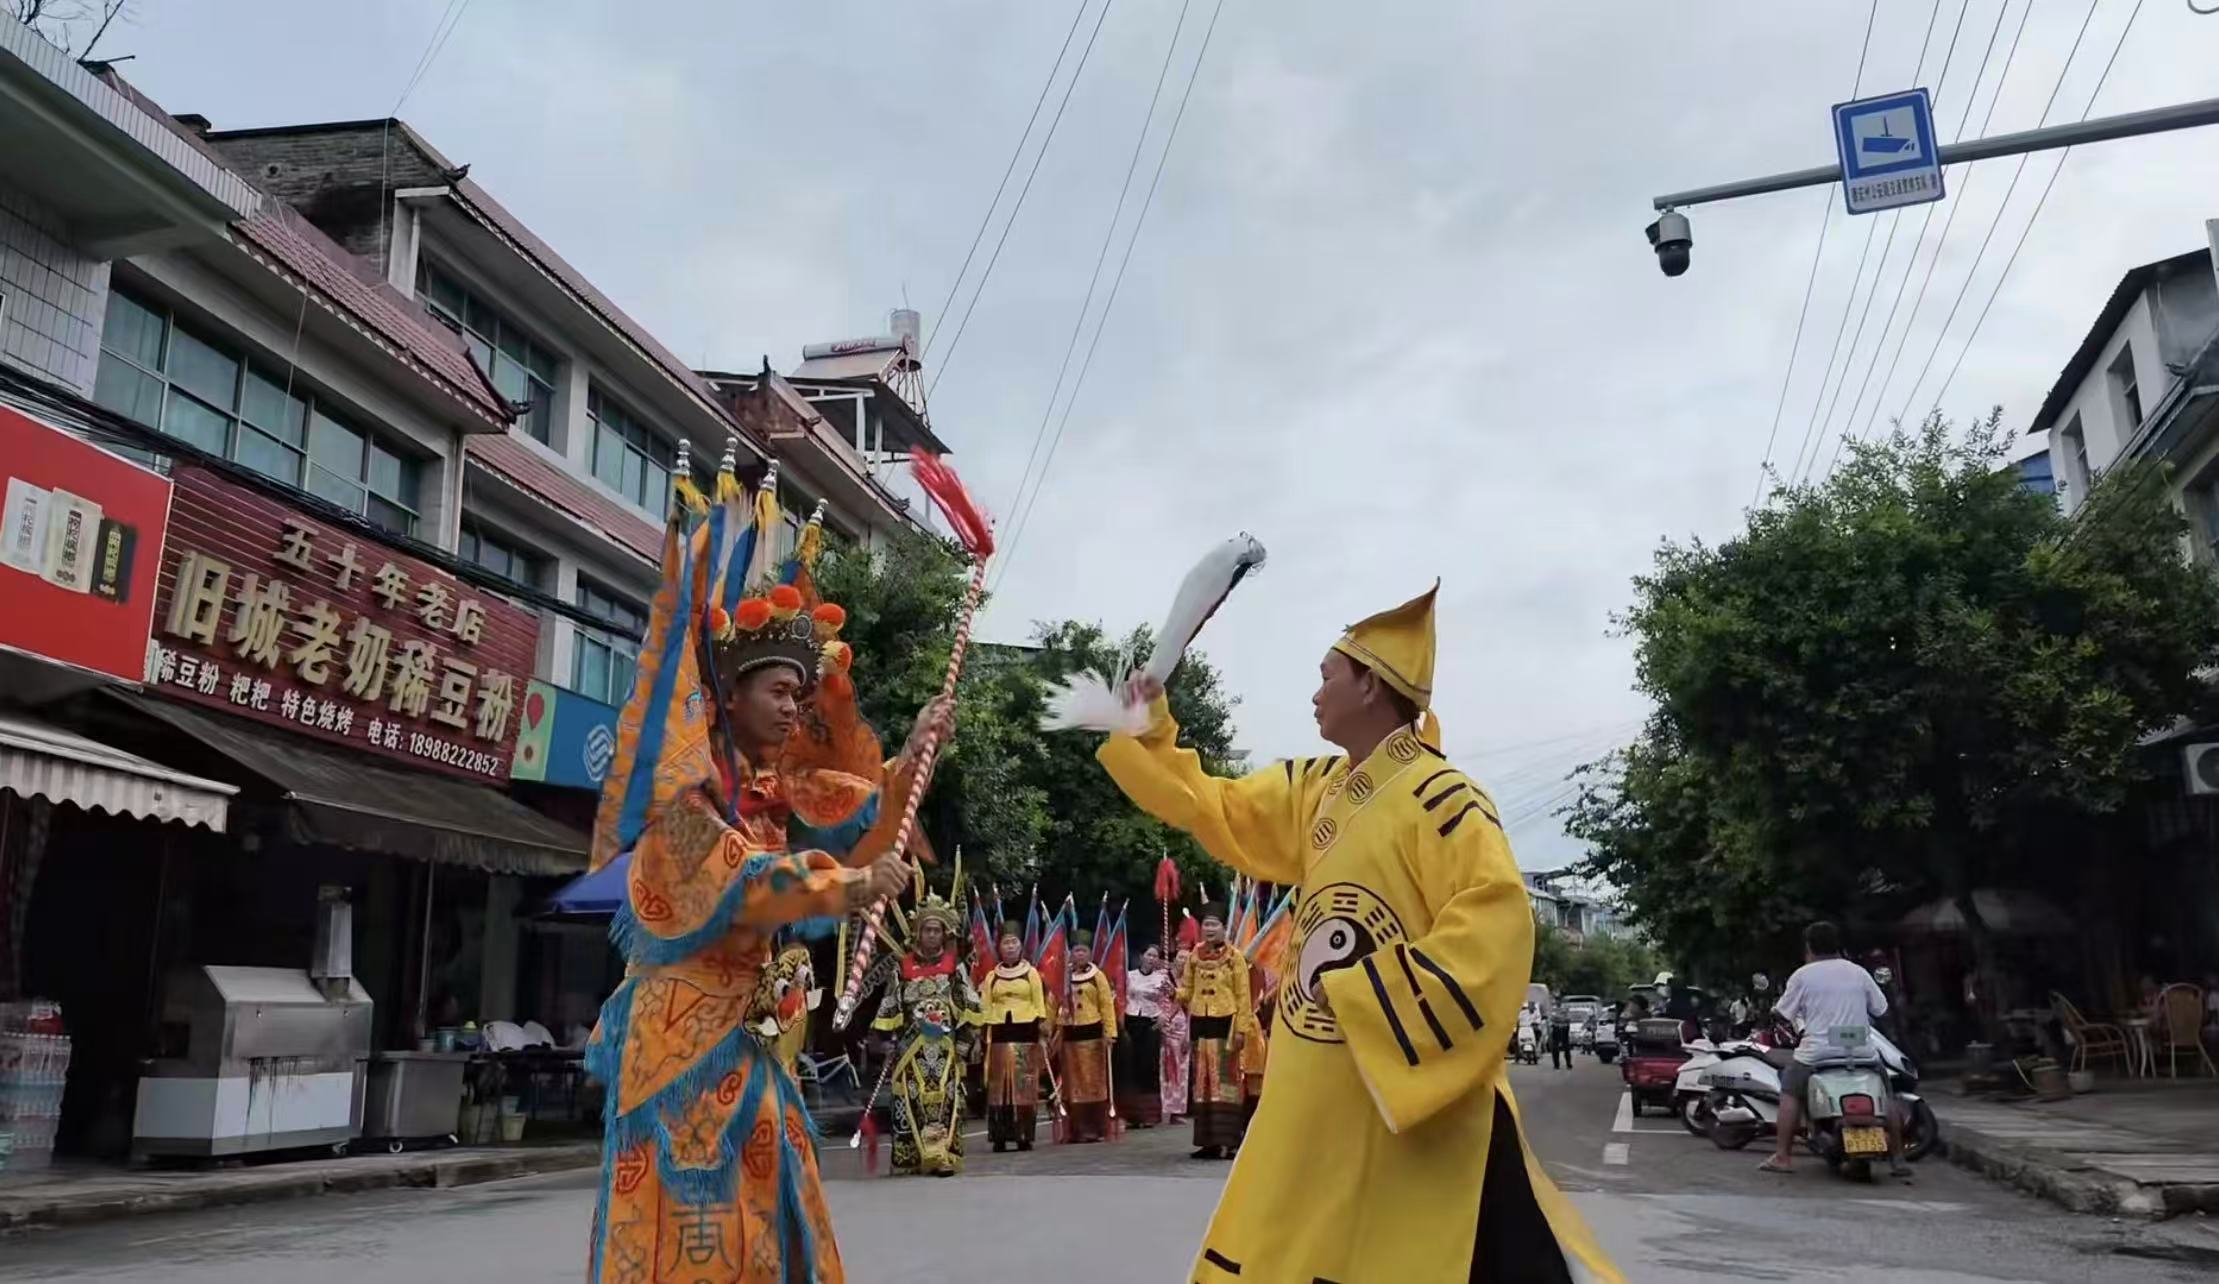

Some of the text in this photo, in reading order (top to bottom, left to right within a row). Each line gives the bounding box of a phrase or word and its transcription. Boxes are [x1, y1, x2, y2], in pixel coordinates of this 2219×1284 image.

[273, 518, 487, 645] 五十年老店
[164, 550, 514, 741] 旧城老奶稀豆粉
[229, 671, 271, 710] 粑粑
[280, 688, 354, 736] 特色烧烤
